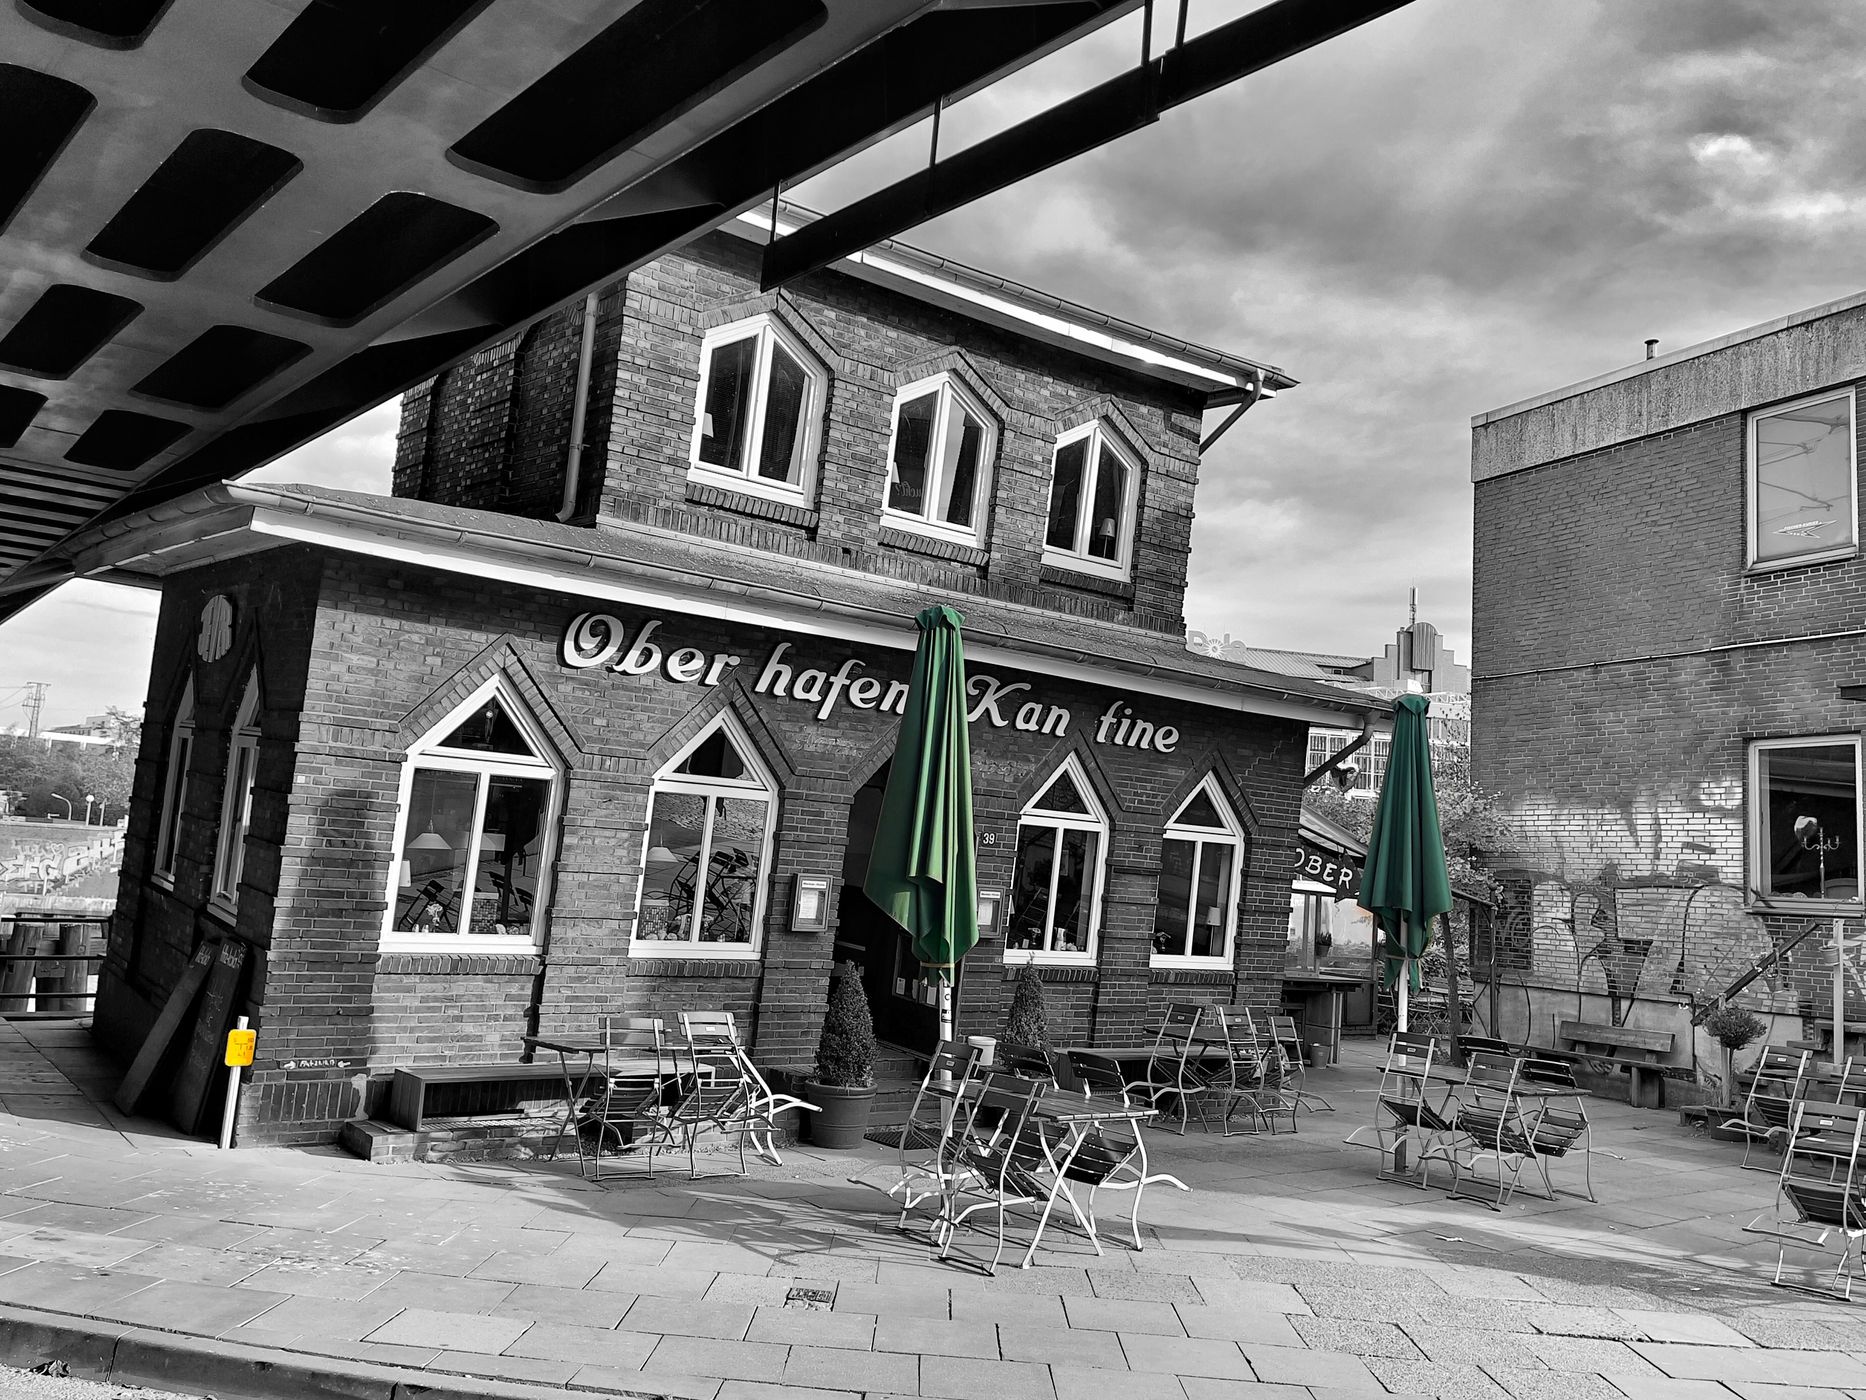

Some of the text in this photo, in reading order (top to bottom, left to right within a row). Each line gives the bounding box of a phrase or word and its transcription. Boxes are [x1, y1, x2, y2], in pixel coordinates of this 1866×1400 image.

[564, 612, 1180, 753] Ober hafen Kan tine
[982, 832, 995, 845] 39
